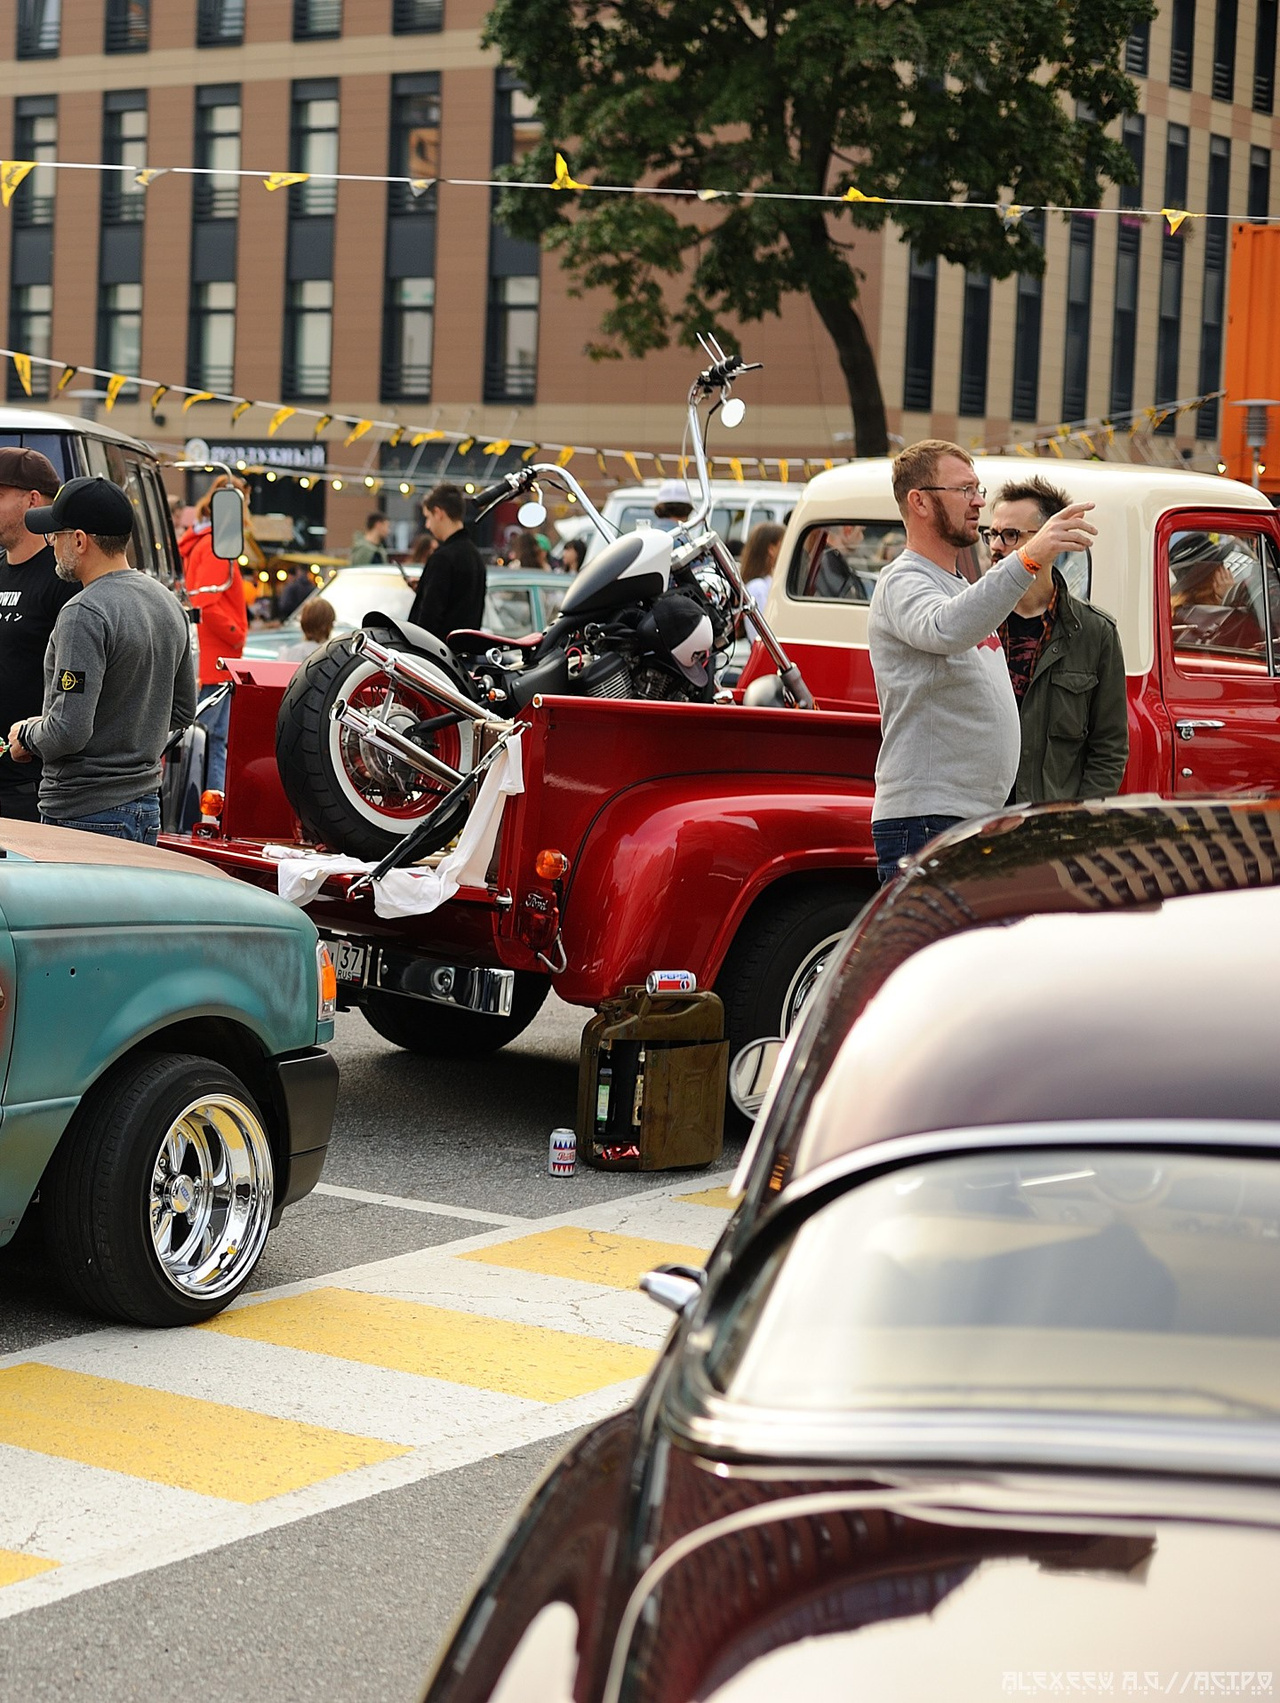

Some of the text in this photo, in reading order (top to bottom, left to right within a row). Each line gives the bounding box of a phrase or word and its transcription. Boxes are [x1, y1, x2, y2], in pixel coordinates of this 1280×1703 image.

[525, 893, 548, 911] Ford
[340, 946, 360, 970] 37
[338, 969, 352, 980] RUS
